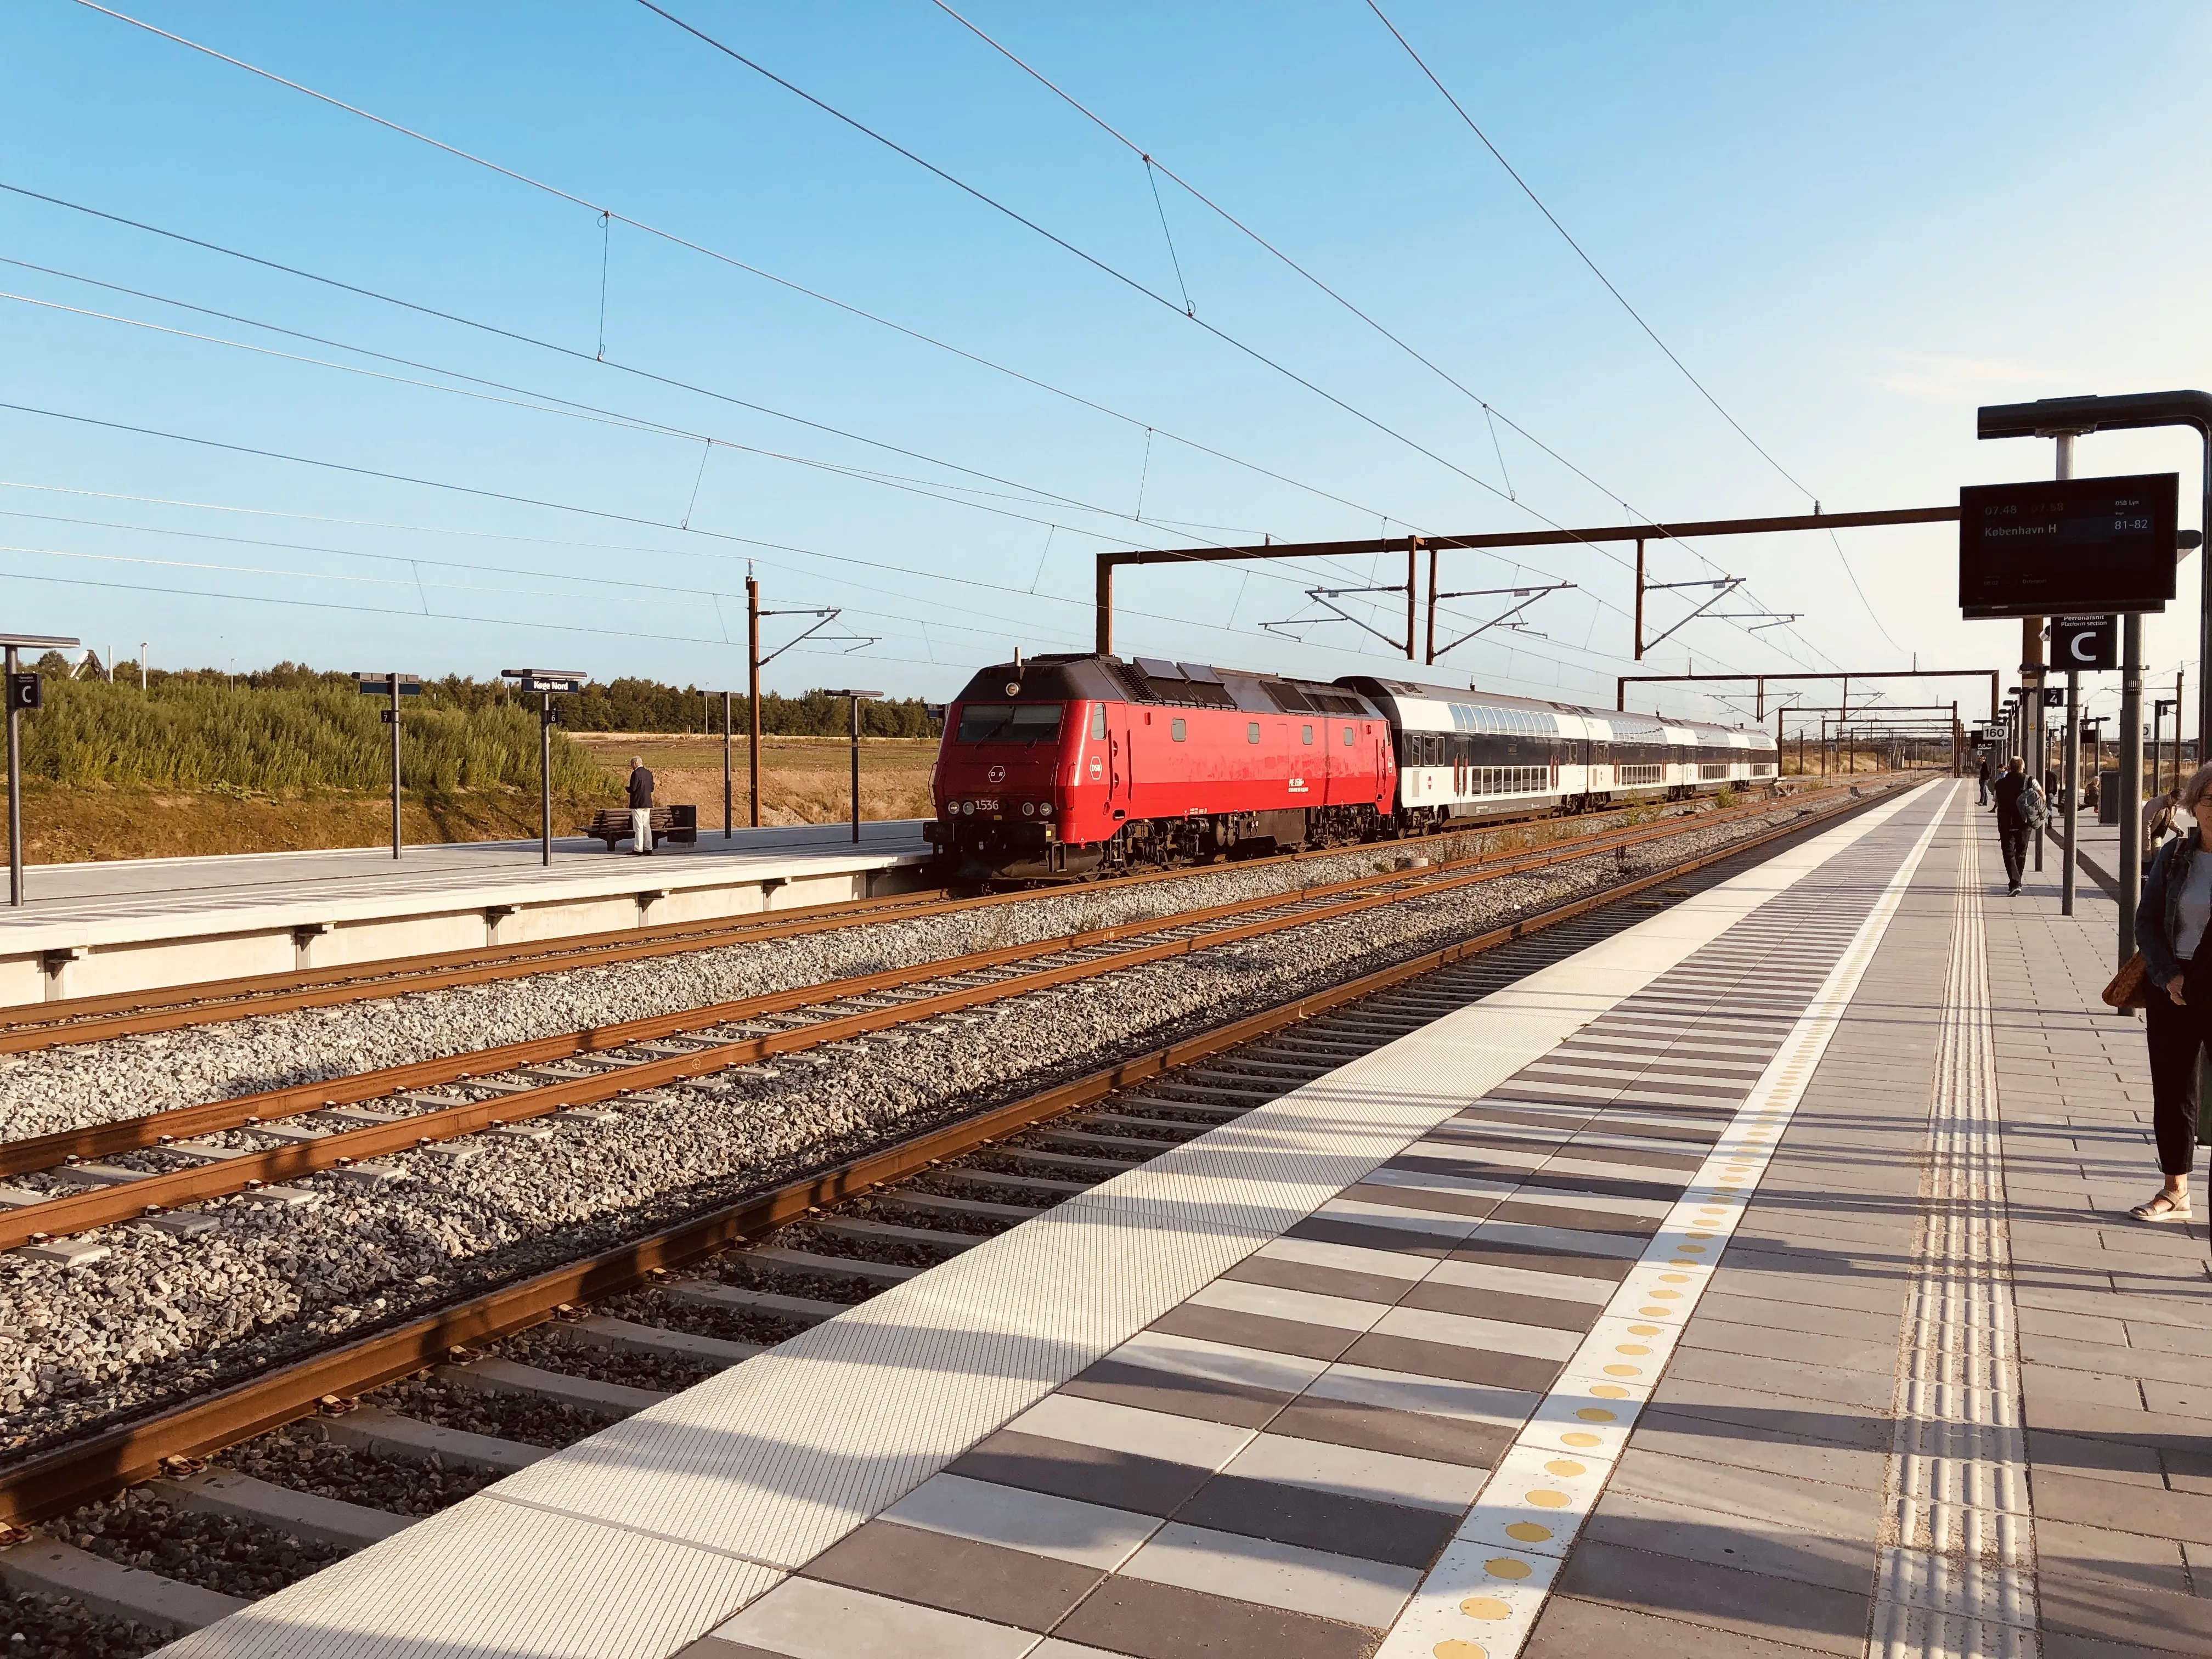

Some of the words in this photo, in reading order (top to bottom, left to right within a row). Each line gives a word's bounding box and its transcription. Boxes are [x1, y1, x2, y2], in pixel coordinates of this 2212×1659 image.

[1985, 505, 2017, 515] 07.48
[2115, 519, 2148, 530] 81-82
[1985, 526, 2044, 537] København
[2049, 524, 2056, 534] H
[2071, 631, 2097, 661] C
[534, 680, 551, 691] Køge
[551, 681, 568, 690] Nord
[22, 685, 32, 703] C
[2050, 695, 2057, 704] 4
[1985, 728, 2005, 737] 160
[975, 800, 999, 810] 1536
